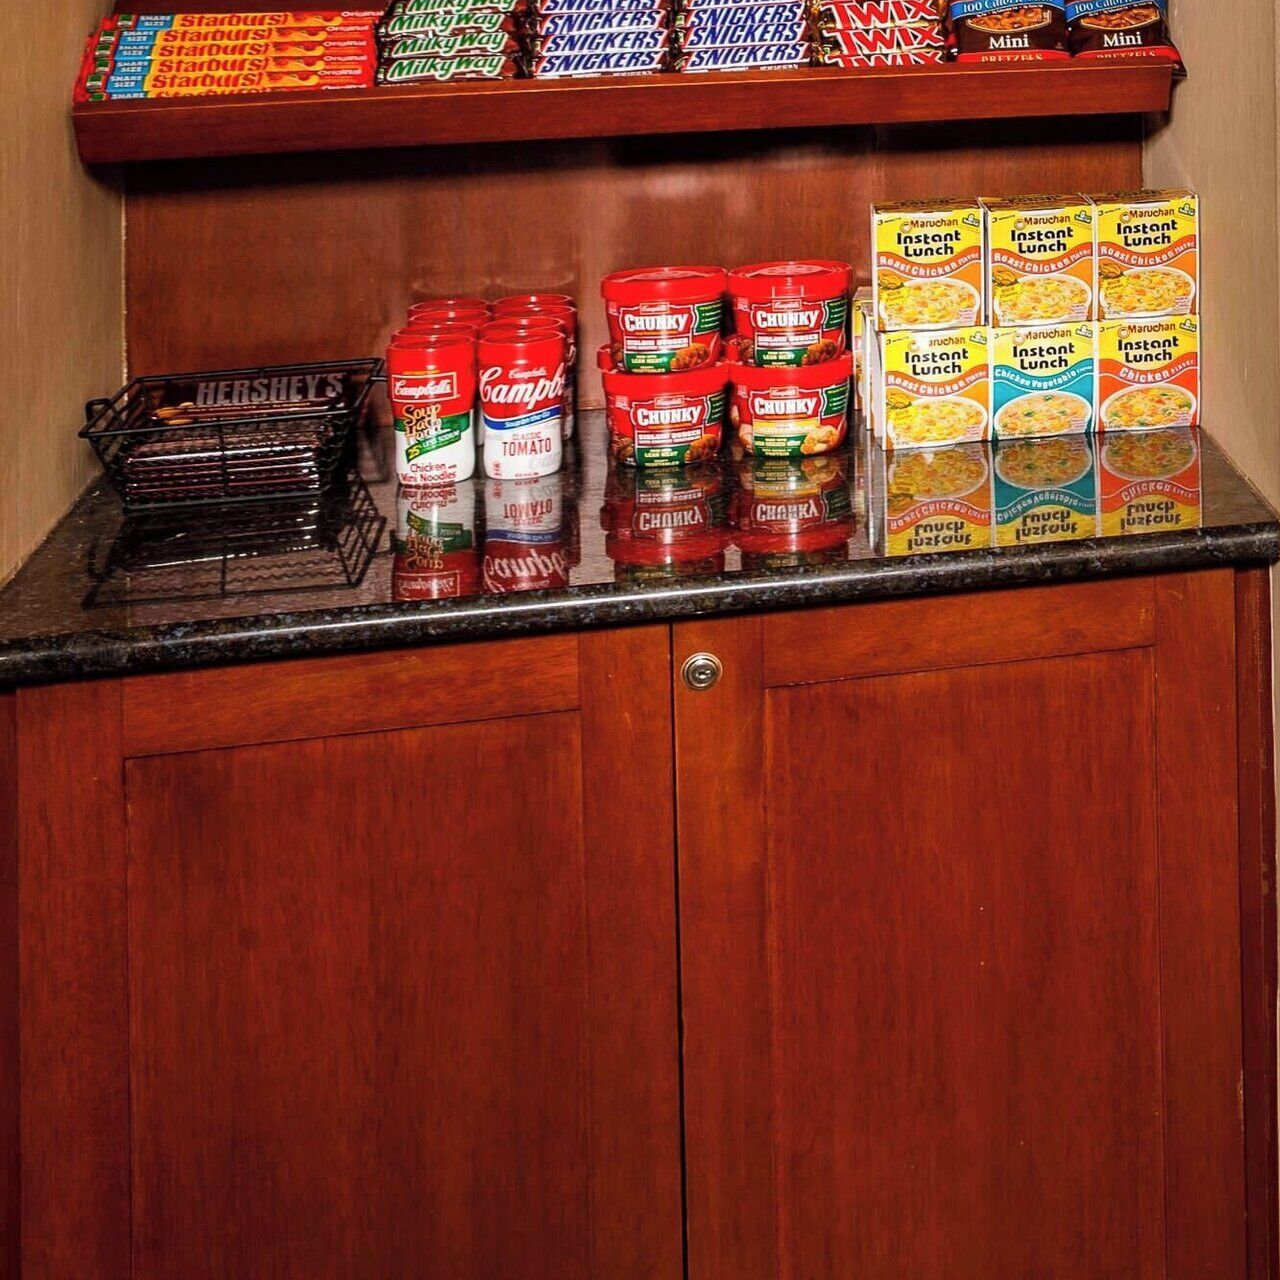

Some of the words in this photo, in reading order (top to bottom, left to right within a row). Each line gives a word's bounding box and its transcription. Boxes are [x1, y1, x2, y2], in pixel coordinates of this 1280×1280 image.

[964, 1, 982, 12] 100
[1075, 3, 1093, 13] 100
[690, 4, 801, 27] SNICKERS
[544, 12, 659, 34] SNICKERS
[689, 23, 802, 46] SNICKERS
[823, 26, 944, 56] TWIX
[1104, 33, 1142, 47] Mini
[549, 31, 664, 54] SNICKERS
[989, 35, 1029, 49] Mini
[542, 52, 659, 72] SNICKERS
[691, 44, 804, 67] SNICKERS
[1024, 215, 1070, 225] Maruchan
[1117, 220, 1178, 234] Instant
[897, 231, 961, 244] Instant
[1011, 228, 1073, 241] Instant
[1124, 233, 1171, 246] Lunch
[904, 244, 953, 256] Lunch
[1018, 240, 1067, 254] Lunch
[624, 314, 689, 331] CHUNKY
[756, 310, 818, 328] CHUNKY
[1013, 344, 1074, 357] Instant
[1118, 337, 1178, 350] Instant
[905, 349, 968, 361] Instant
[1125, 350, 1172, 363] Lunch
[912, 362, 961, 375] Lunch
[1020, 357, 1068, 369] Lunch
[197, 374, 342, 405] HERSHEY'S
[754, 397, 817, 415] CHUNKY
[637, 407, 702, 425] CHUNKY
[502, 438, 551, 456] TOMATO
[410, 463, 446, 472] Chicken
[422, 471, 456, 482] Noodles
